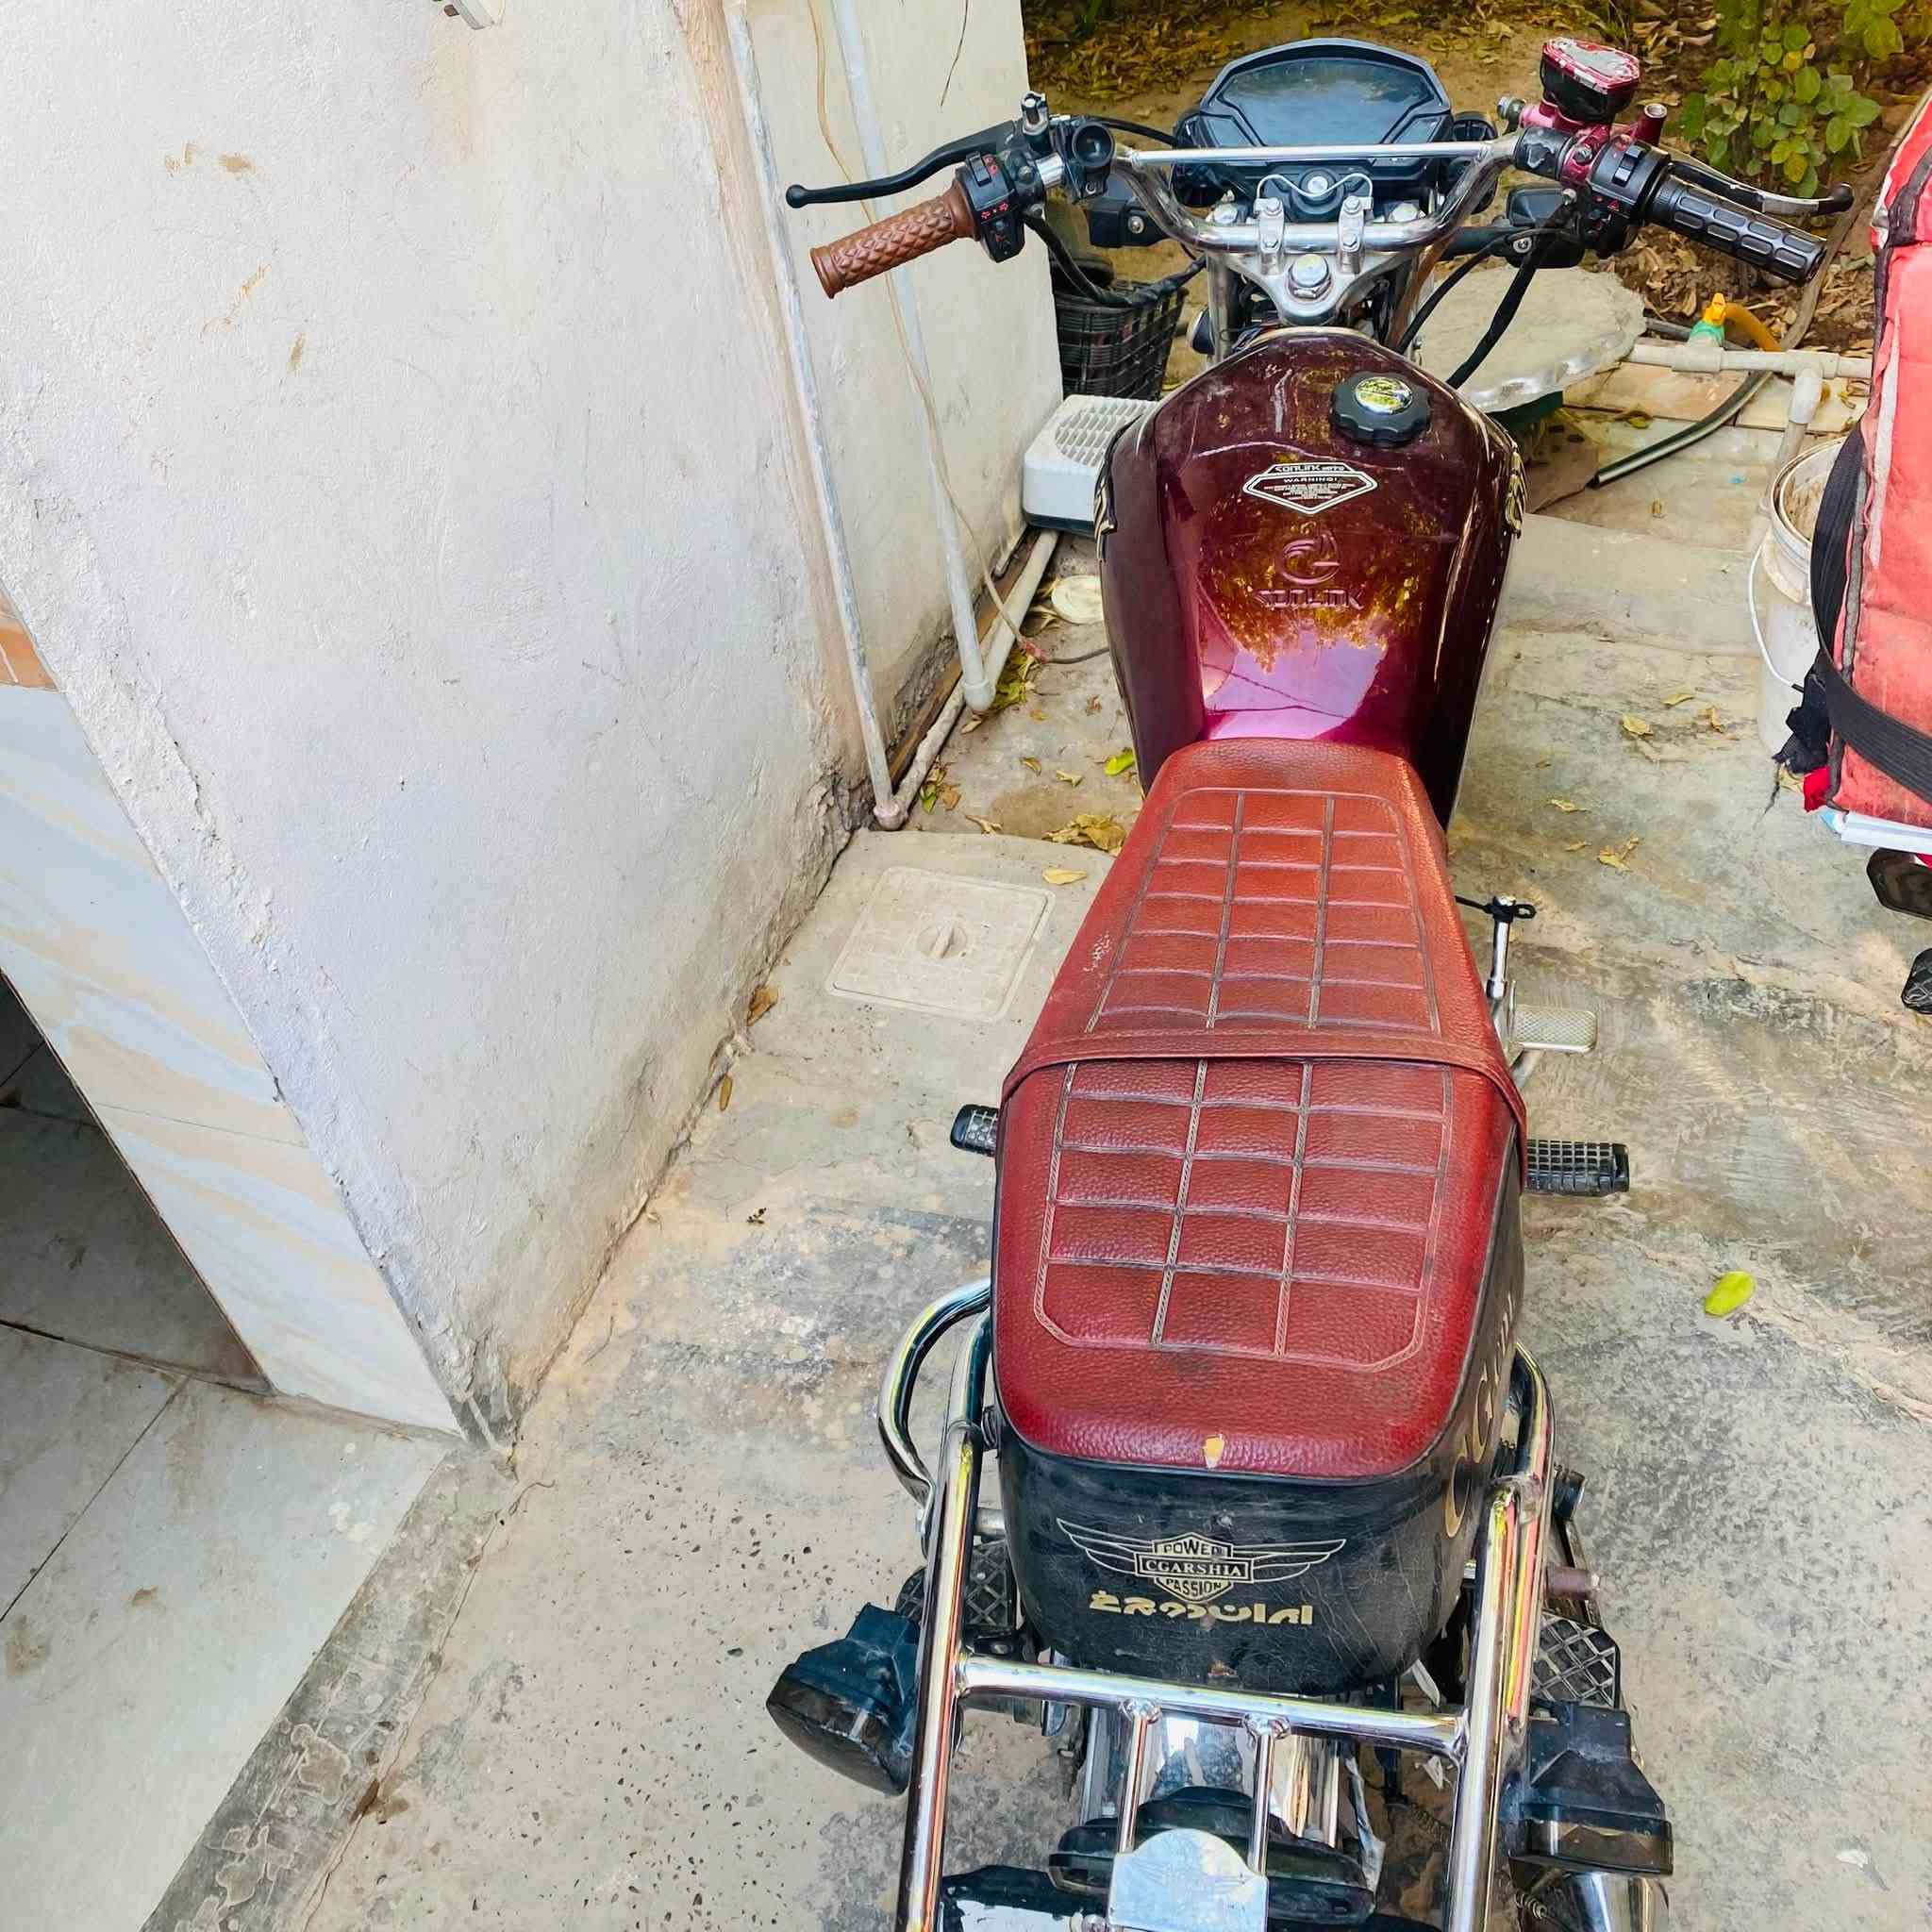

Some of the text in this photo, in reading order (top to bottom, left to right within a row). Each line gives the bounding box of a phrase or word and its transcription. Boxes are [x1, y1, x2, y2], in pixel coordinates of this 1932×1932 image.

[1163, 1539, 1224, 1557] POWER
[1145, 1558, 1242, 1576] CGARSHIA
[1166, 1579, 1223, 1597] PASSION
